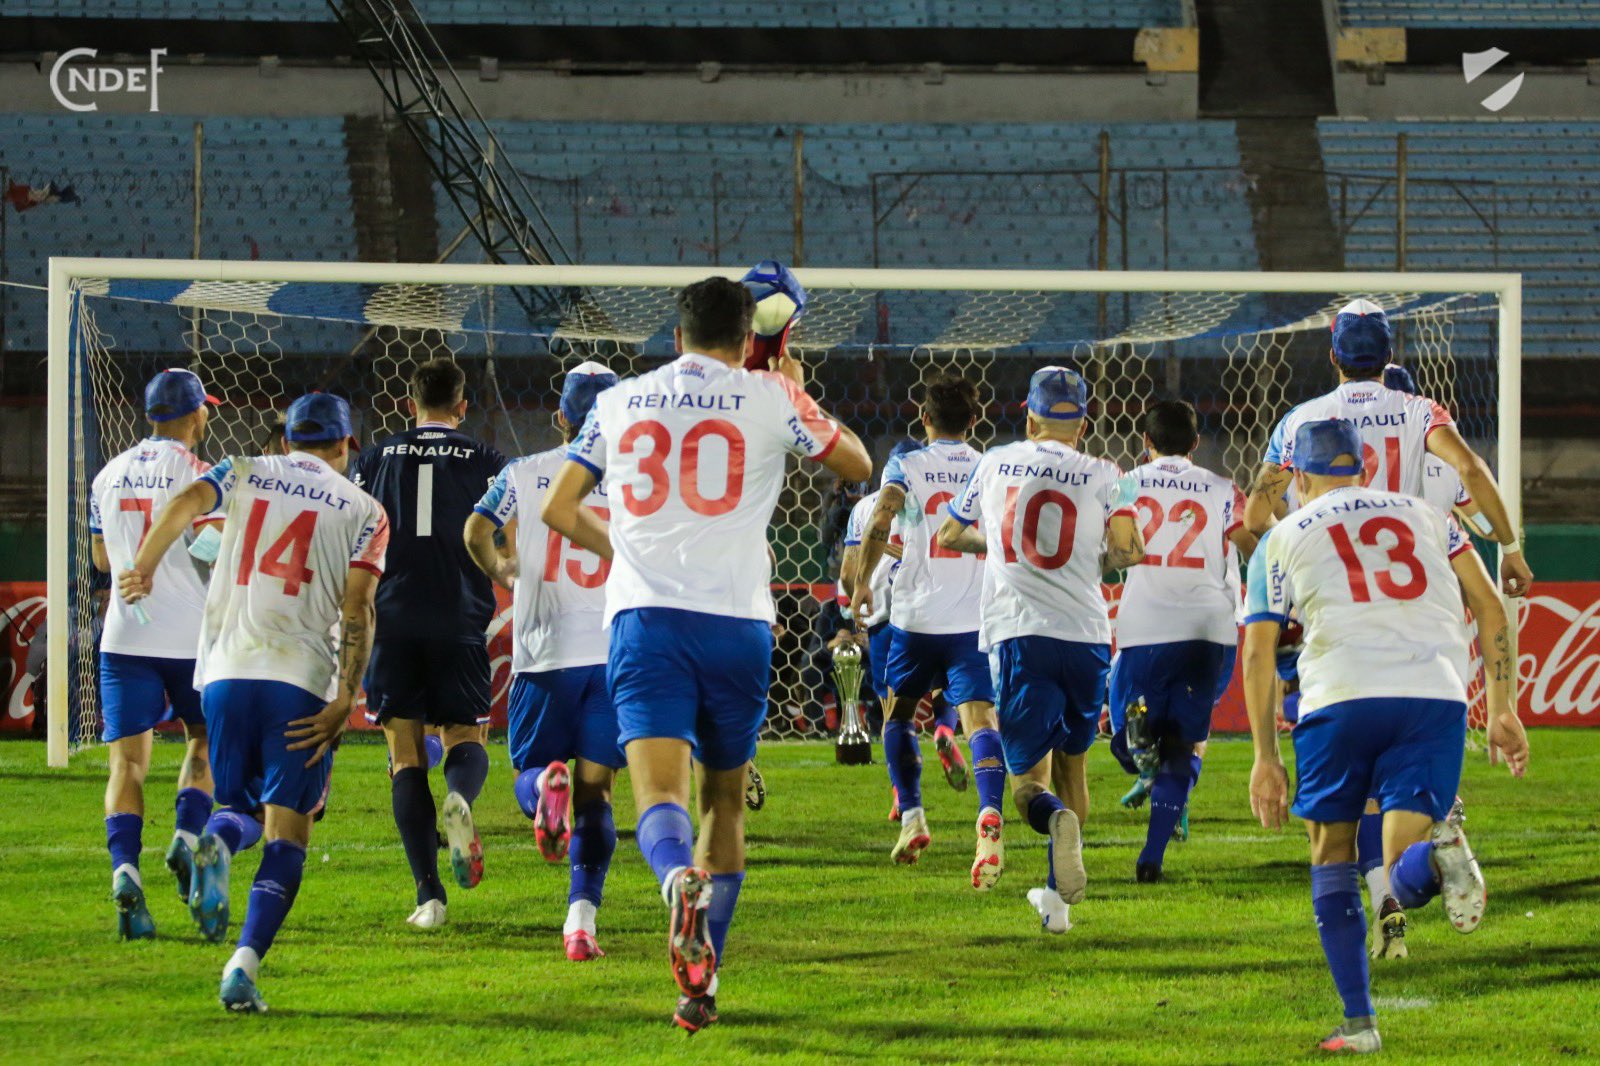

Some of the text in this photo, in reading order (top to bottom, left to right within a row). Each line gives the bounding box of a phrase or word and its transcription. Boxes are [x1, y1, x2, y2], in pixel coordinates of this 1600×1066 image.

[627, 394, 746, 411] RENAULT
[382, 444, 474, 459] RENAULT
[619, 419, 745, 517] 30
[925, 472, 970, 484] RENA
[999, 463, 1093, 486] RENAULT
[247, 474, 351, 511] RENAULT
[416, 463, 433, 537] 1
[1141, 478, 1212, 493] ENAULT
[119, 498, 153, 557] 7
[236, 497, 319, 597] 14
[1001, 486, 1077, 570] 10
[1134, 496, 1208, 569] 22
[1327, 515, 1428, 603] 13
